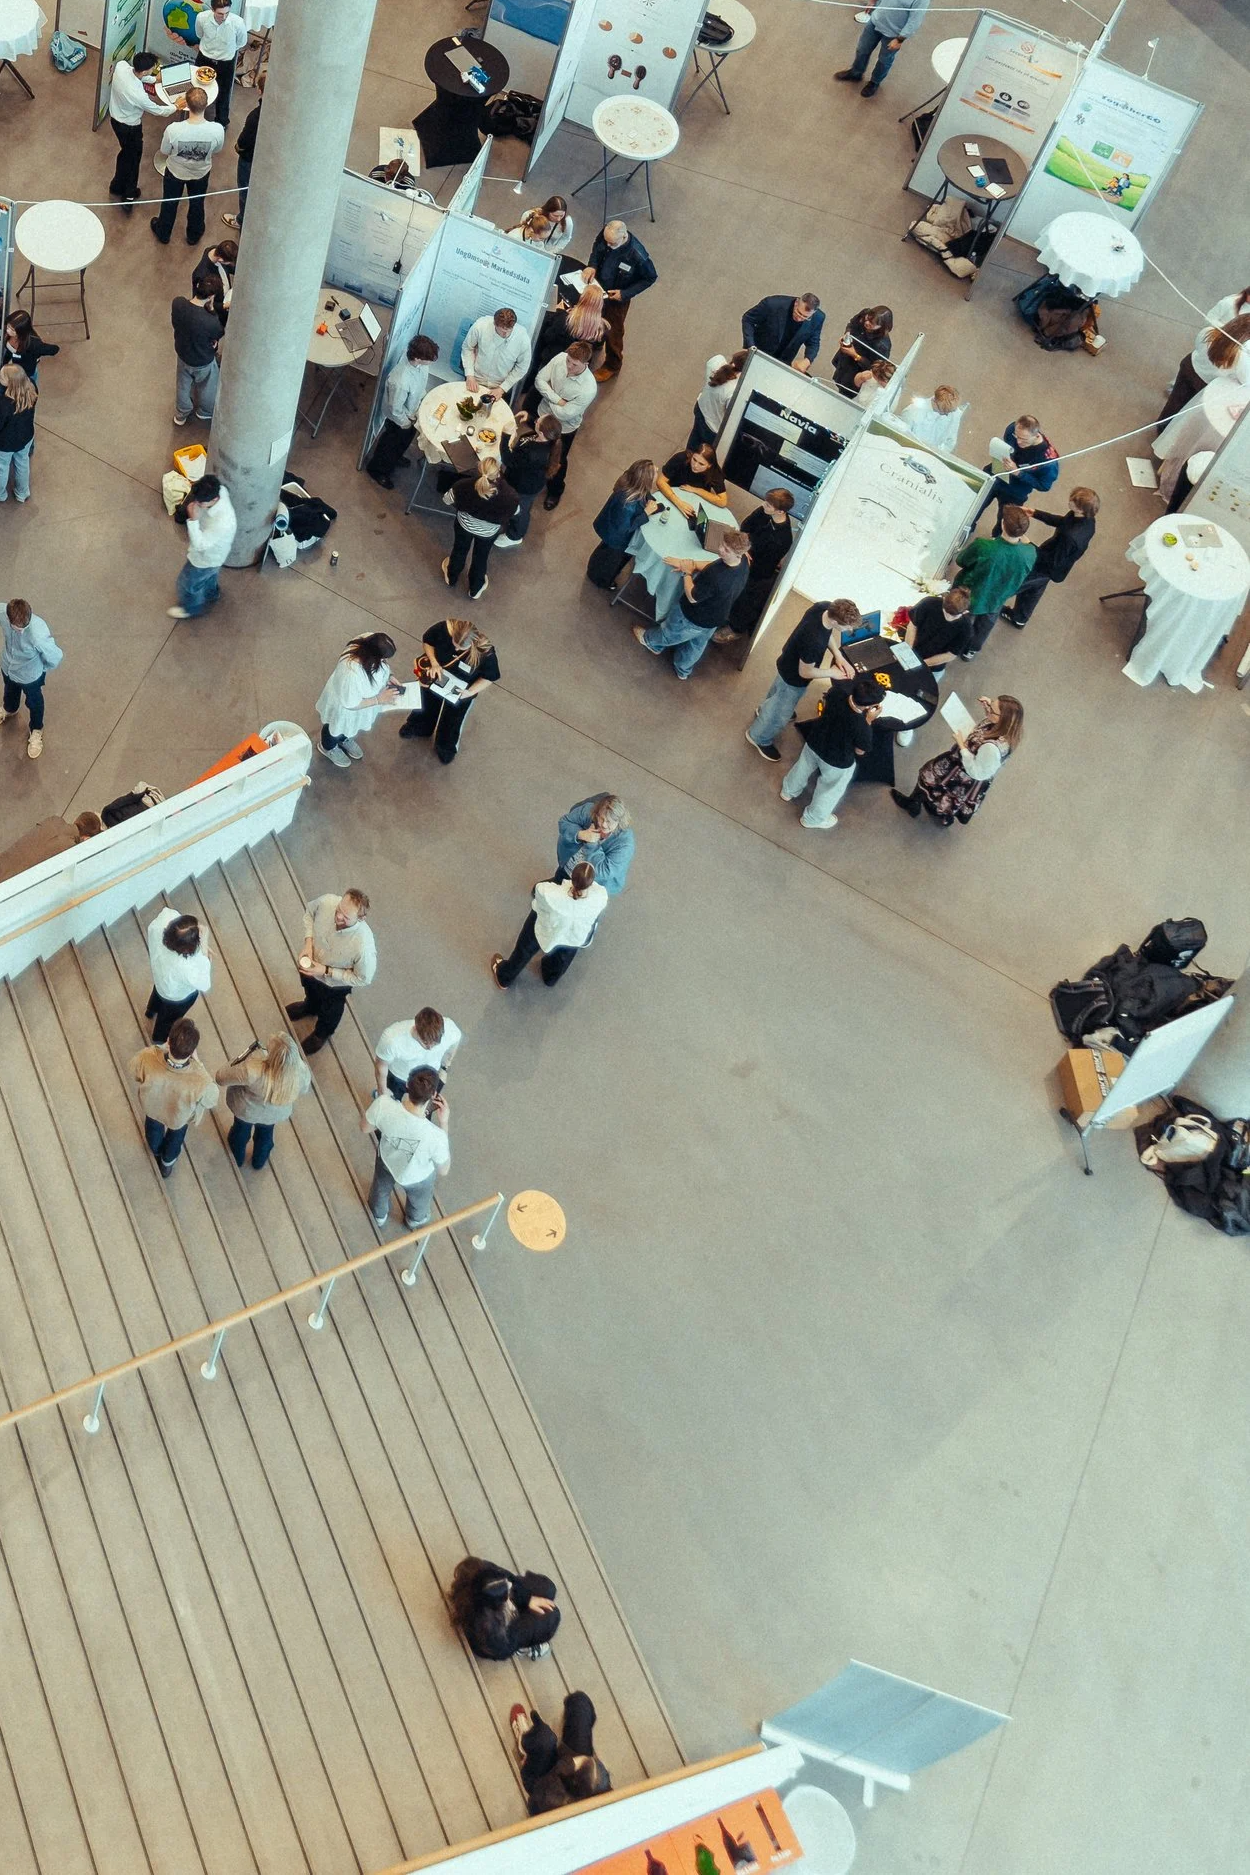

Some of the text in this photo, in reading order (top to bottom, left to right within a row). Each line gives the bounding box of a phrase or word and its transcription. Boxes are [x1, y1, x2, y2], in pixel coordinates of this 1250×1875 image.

[491, 262, 531, 285] Markedsdata
[780, 409, 818, 435] Navia
[880, 462, 944, 504] Cranialis
